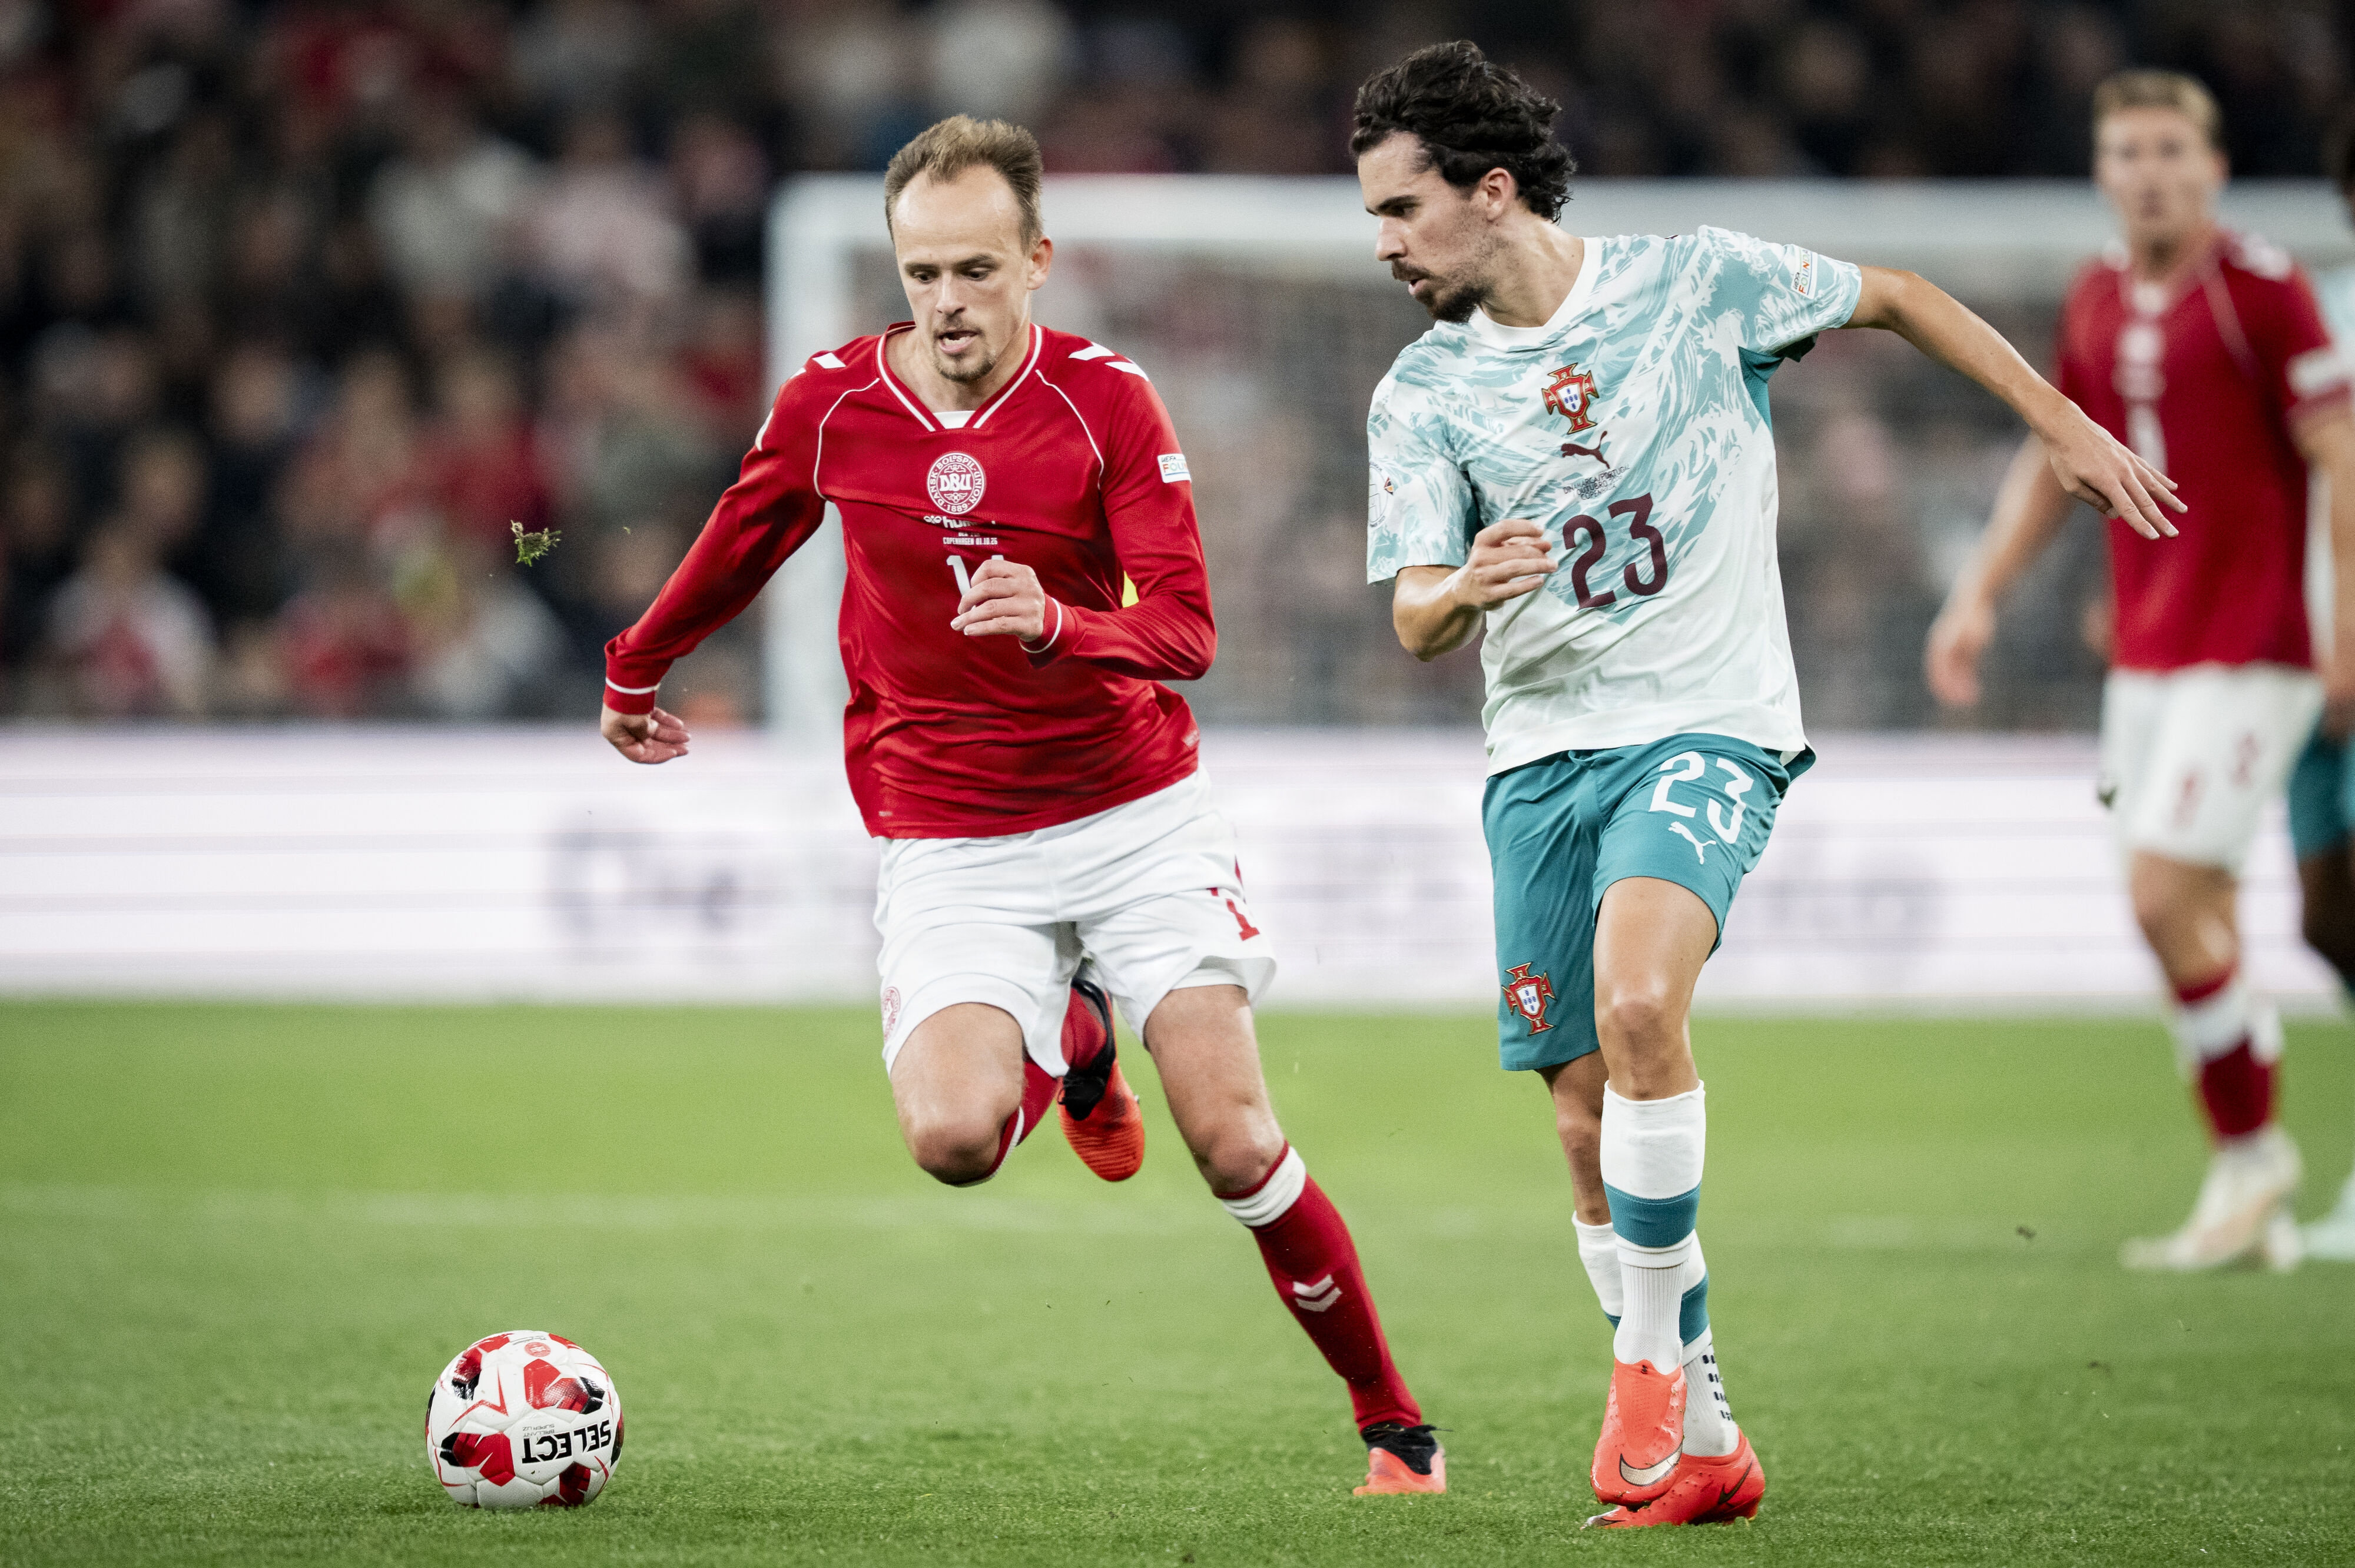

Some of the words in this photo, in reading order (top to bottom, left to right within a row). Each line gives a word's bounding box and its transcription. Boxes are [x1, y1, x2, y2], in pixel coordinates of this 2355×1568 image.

[930, 471, 945, 506] DANSK
[939, 473, 972, 491] DBU
[968, 471, 982, 504] UNION
[946, 503, 968, 512] 1889
[1563, 492, 1668, 612] 23
[1648, 751, 1754, 844] 23
[522, 1419, 611, 1464] SELECT
